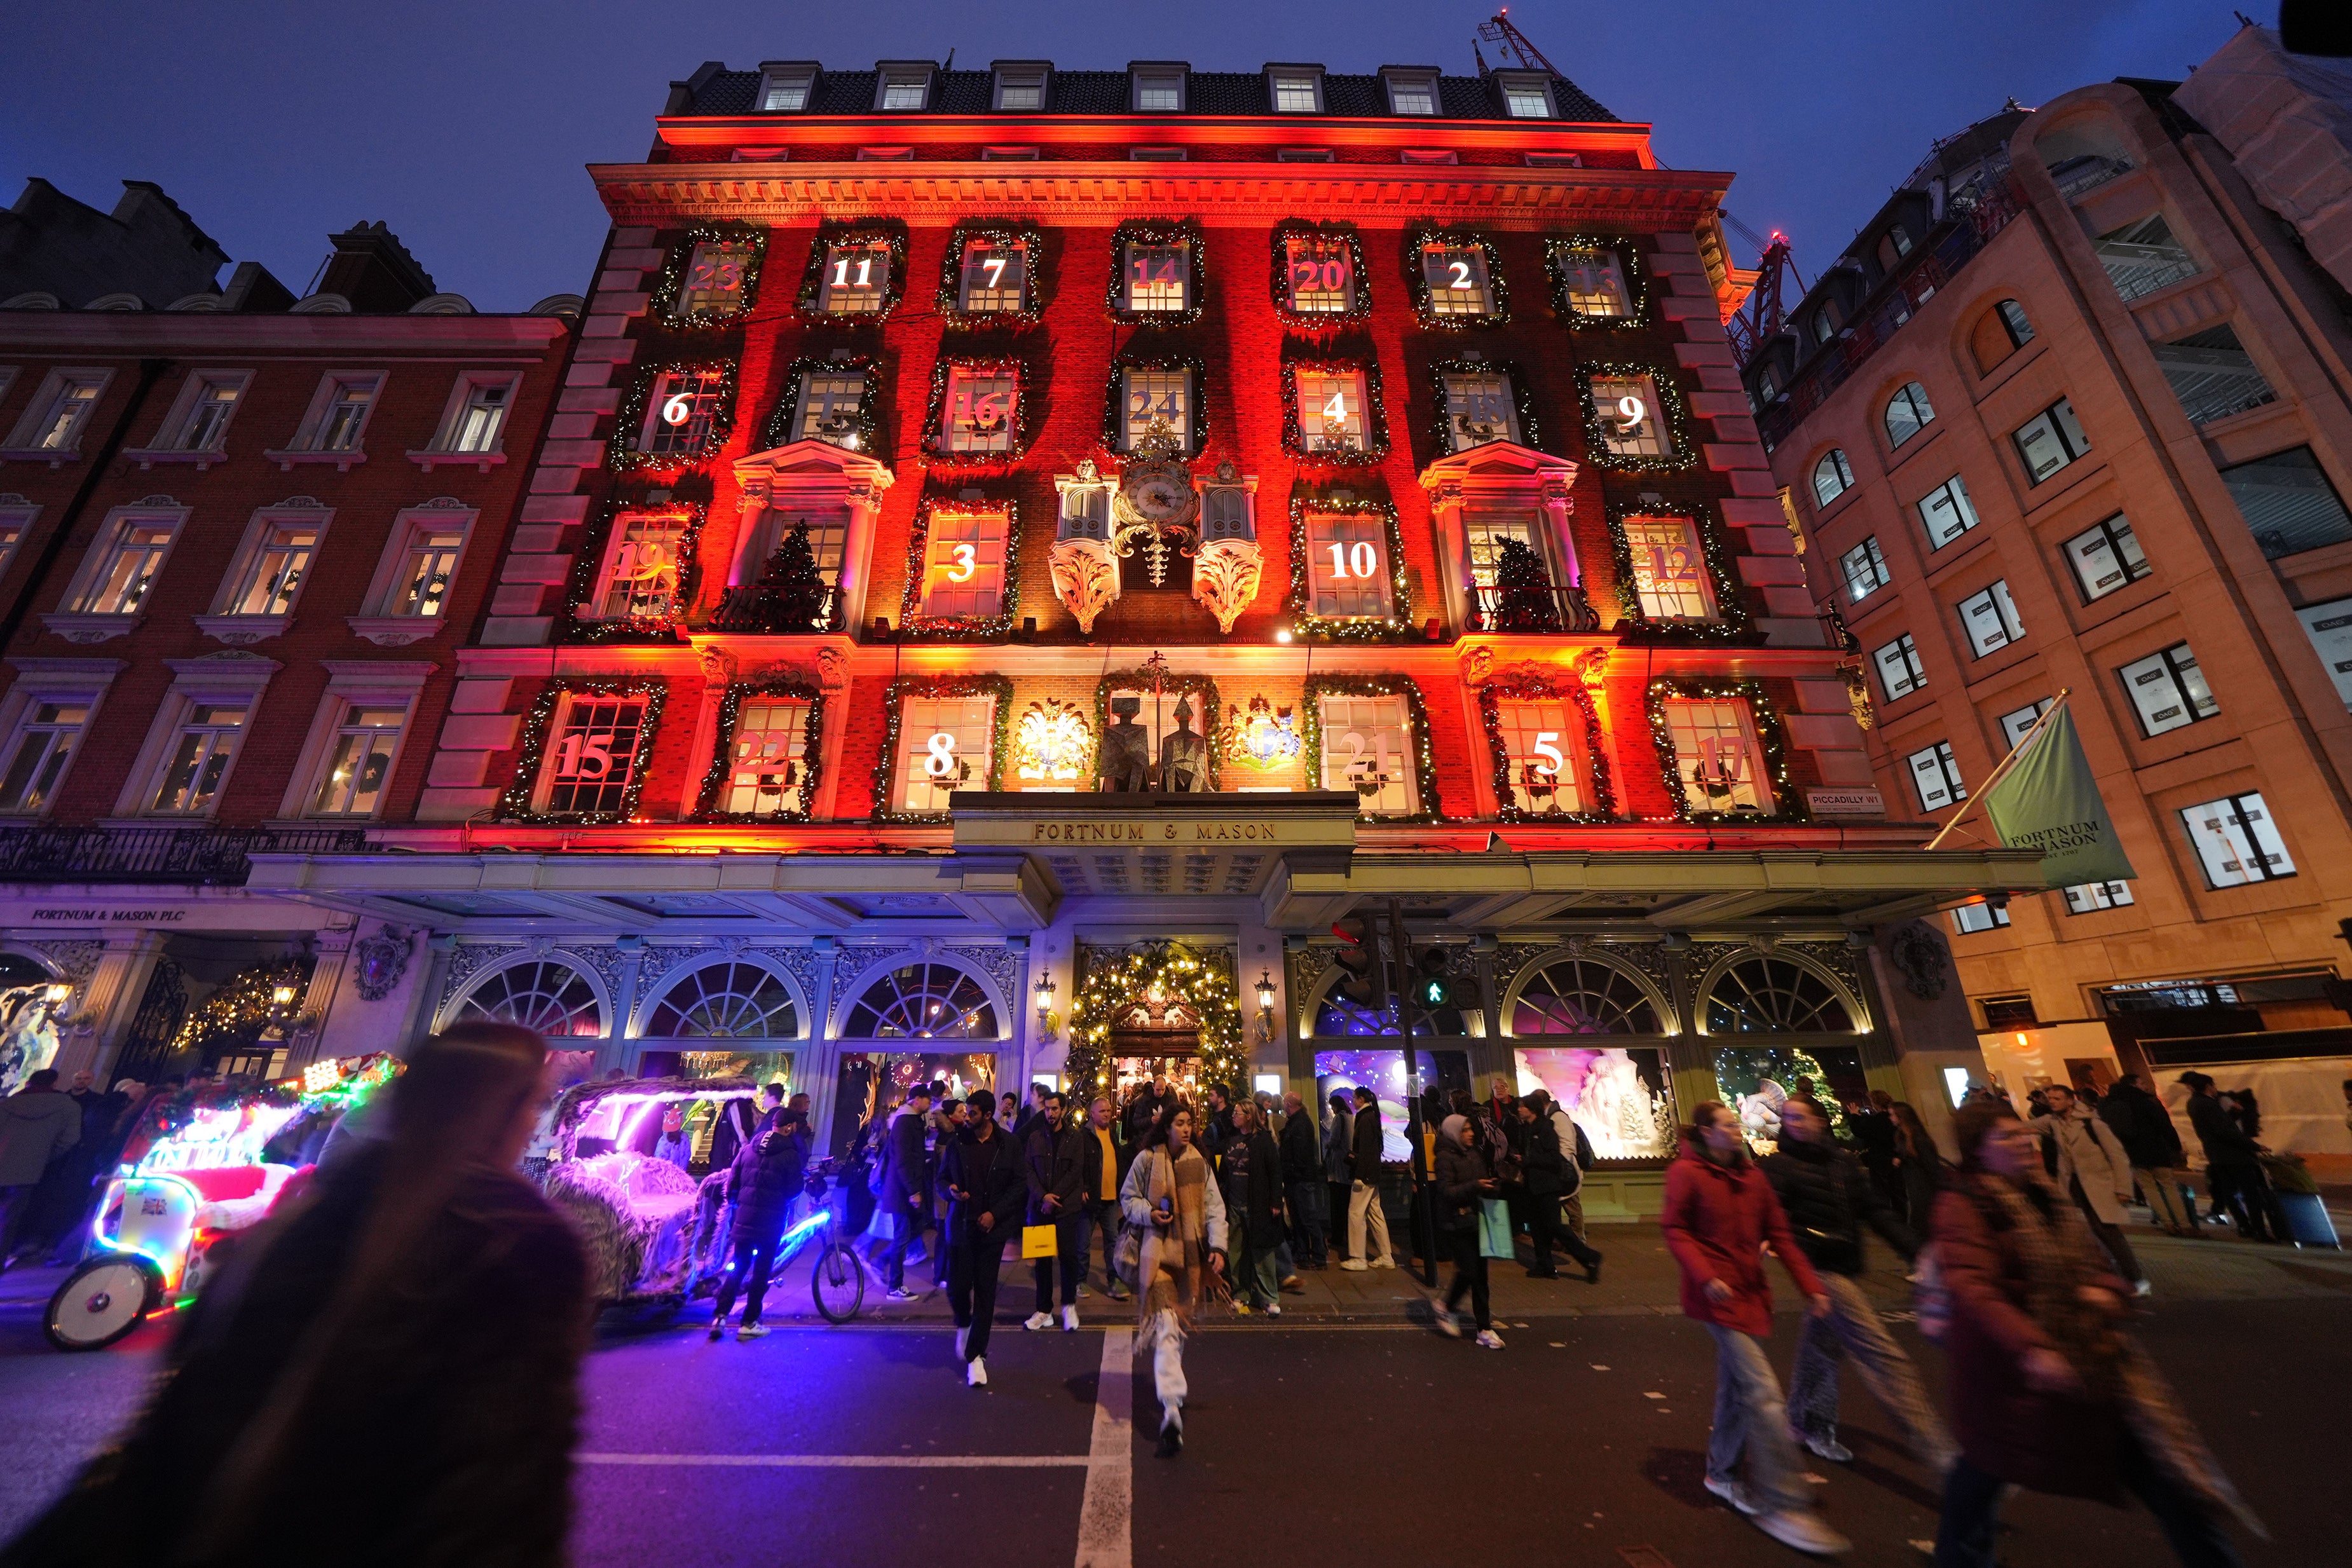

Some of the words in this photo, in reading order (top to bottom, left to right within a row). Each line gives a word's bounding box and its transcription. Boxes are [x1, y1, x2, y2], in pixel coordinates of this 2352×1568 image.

[690, 261, 741, 290] 23
[830, 259, 873, 289] 11
[982, 259, 1006, 288] 7
[1133, 258, 1177, 289] 14
[1297, 261, 1344, 291] 20
[1449, 262, 1472, 290] 2
[1576, 266, 1621, 296] 13
[663, 392, 694, 426] 6
[955, 392, 1003, 426] 16
[1130, 391, 1179, 421] 24
[1323, 392, 1348, 423] 4
[1464, 393, 1506, 426] 18
[1618, 396, 1644, 429] 9
[613, 543, 667, 581] 19
[947, 544, 975, 582] 3
[1327, 542, 1377, 578] 10
[1649, 547, 1698, 580] 12
[556, 734, 615, 779] 15
[732, 732, 790, 774] 22
[925, 733, 955, 776] 8
[1341, 732, 1394, 775] 21
[1533, 732, 1564, 775] 5
[1697, 735, 1745, 779] 17
[1034, 824, 1144, 840] FORTNUM
[1165, 824, 1178, 838] &
[1196, 823, 1276, 840] MASON
[2010, 821, 2100, 847] FORTNUM
[2036, 833, 2097, 852] MASON
[32, 910, 95, 920] FORTNUM
[98, 911, 107, 920] &
[112, 911, 157, 921] MASON
[160, 911, 186, 921] PLC
